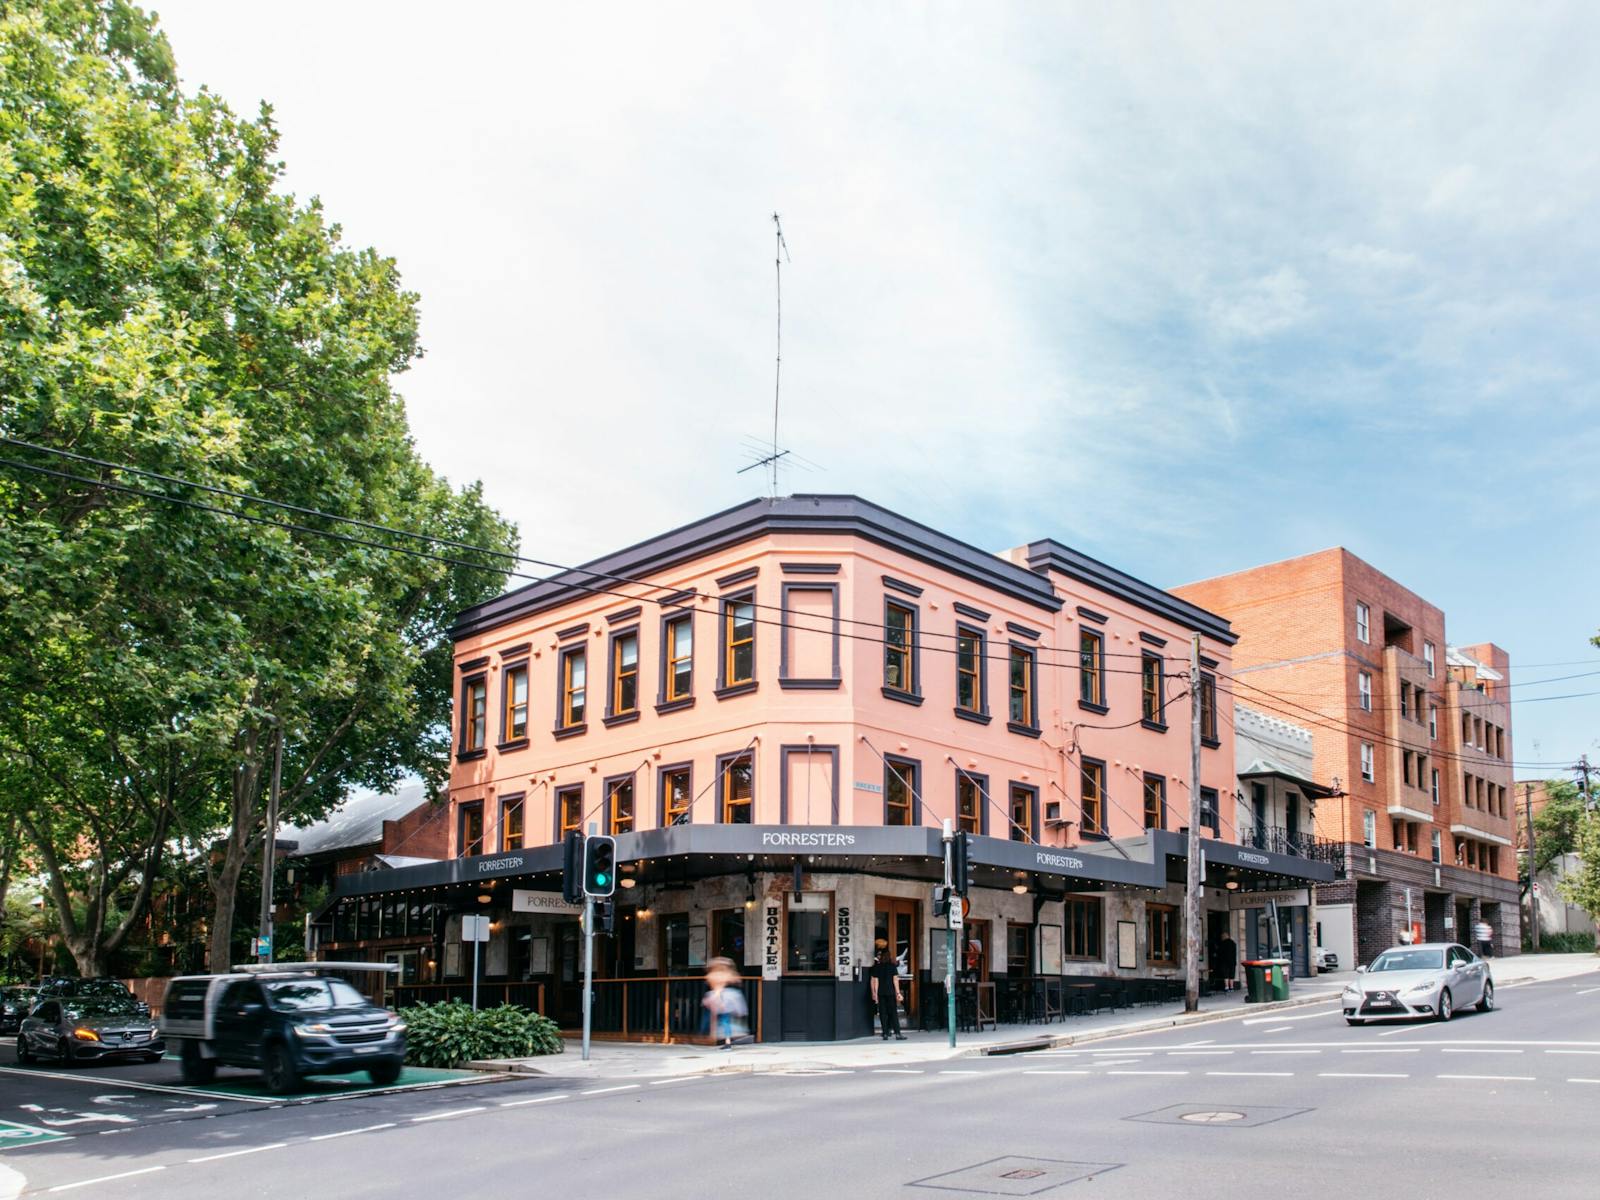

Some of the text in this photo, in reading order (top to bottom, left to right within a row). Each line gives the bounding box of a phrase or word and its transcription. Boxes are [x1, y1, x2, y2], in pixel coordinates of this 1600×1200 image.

[527, 895, 583, 909] FORRES
[766, 907, 778, 965] BOTTLE
[838, 907, 850, 966] SHOPPE
